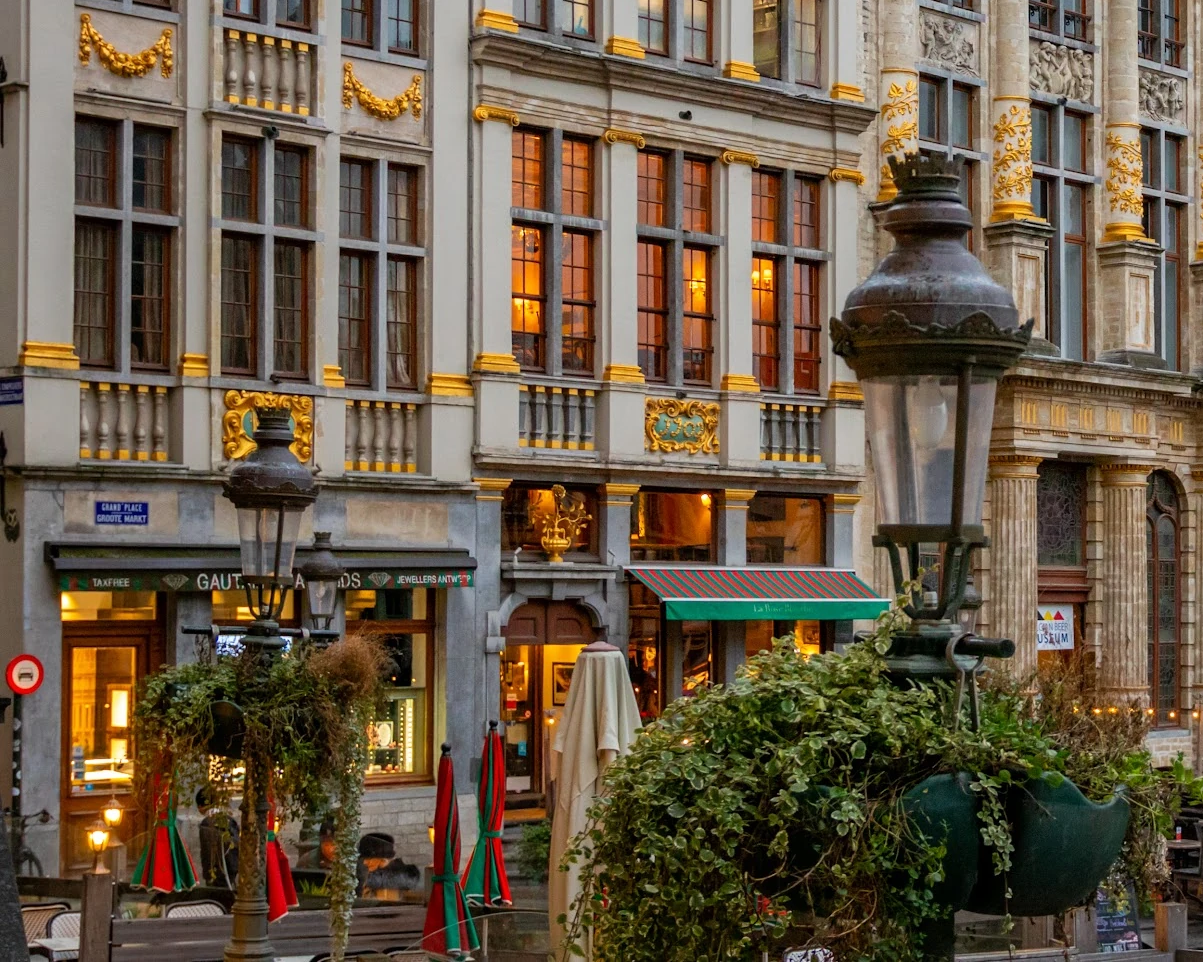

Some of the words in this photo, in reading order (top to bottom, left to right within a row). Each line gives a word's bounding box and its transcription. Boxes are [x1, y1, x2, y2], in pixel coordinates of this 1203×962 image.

[96, 514, 122, 523] GROOTE
[123, 514, 147, 523] MARKT
[92, 577, 131, 587] TAXFREE
[396, 574, 437, 584] JEWELLERS
[1054, 622, 1069, 631] BEER
[1037, 632, 1069, 644] USEUM
